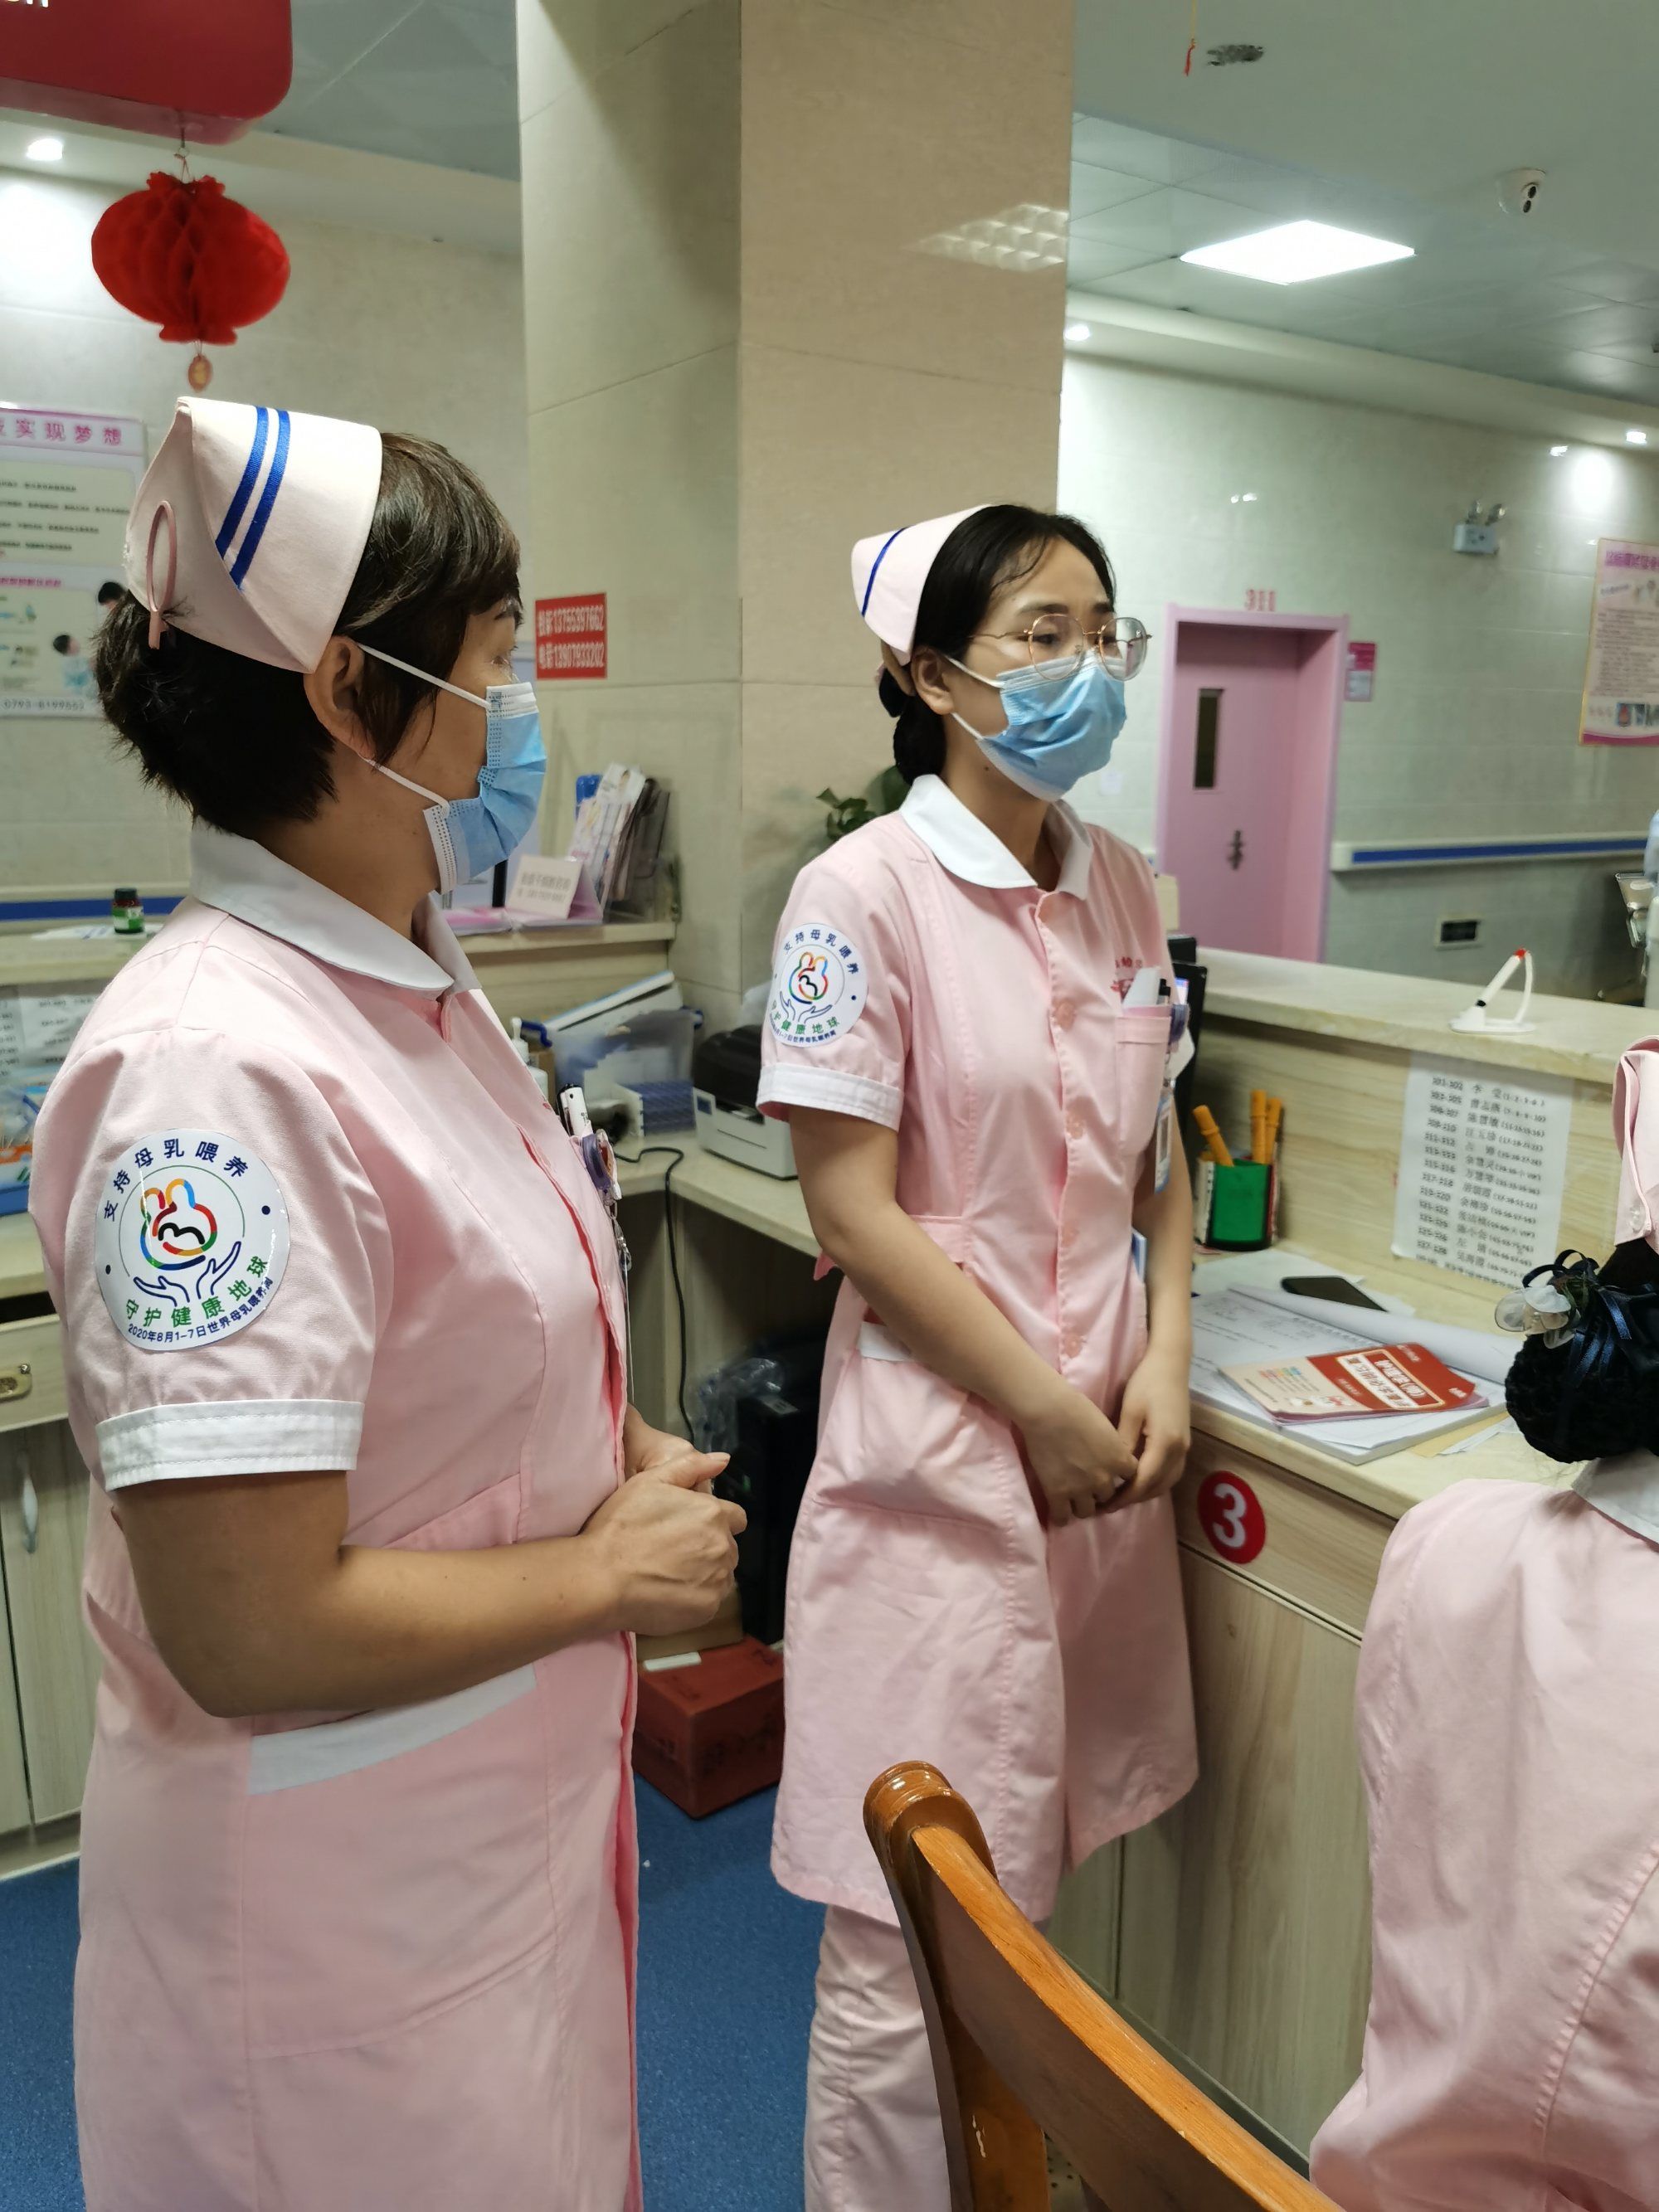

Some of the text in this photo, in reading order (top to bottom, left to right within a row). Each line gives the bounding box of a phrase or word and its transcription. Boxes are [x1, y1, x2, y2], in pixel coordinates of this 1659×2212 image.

[784, 929, 859, 975] 支持母乳喂养
[104, 1138, 248, 1222] 支持母乳喂养
[125, 1256, 268, 1327] 守护健康地球
[1213, 1483, 1246, 1548] 3
